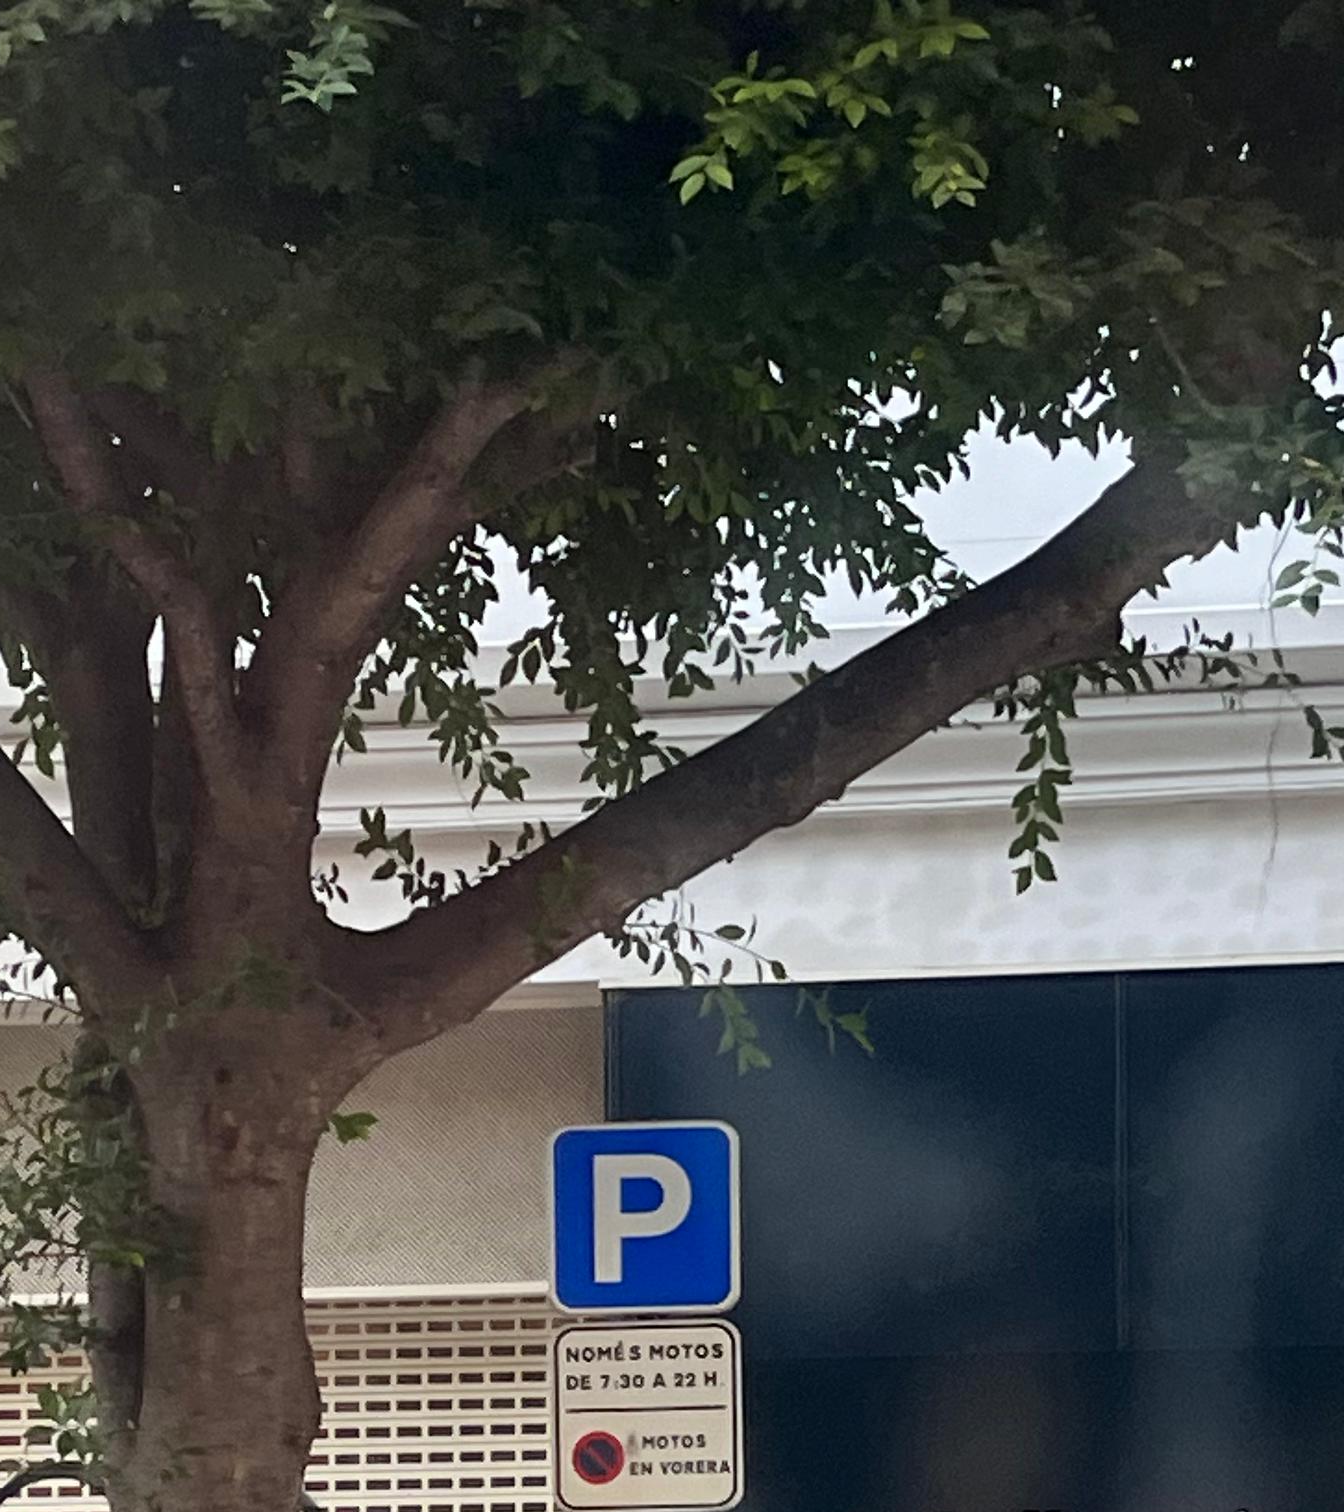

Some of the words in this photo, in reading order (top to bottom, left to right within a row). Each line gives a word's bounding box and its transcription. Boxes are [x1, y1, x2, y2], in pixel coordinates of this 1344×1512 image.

[593, 1154, 692, 1283] P
[565, 1341, 642, 1363] NOMÉS
[649, 1343, 725, 1361] MOTOS
[565, 1374, 593, 1391] DE
[652, 1373, 667, 1389] A
[673, 1373, 697, 1388] 22
[641, 1434, 707, 1450] MOTOS
[629, 1462, 653, 1476] EN
[659, 1460, 732, 1476] VORERA
